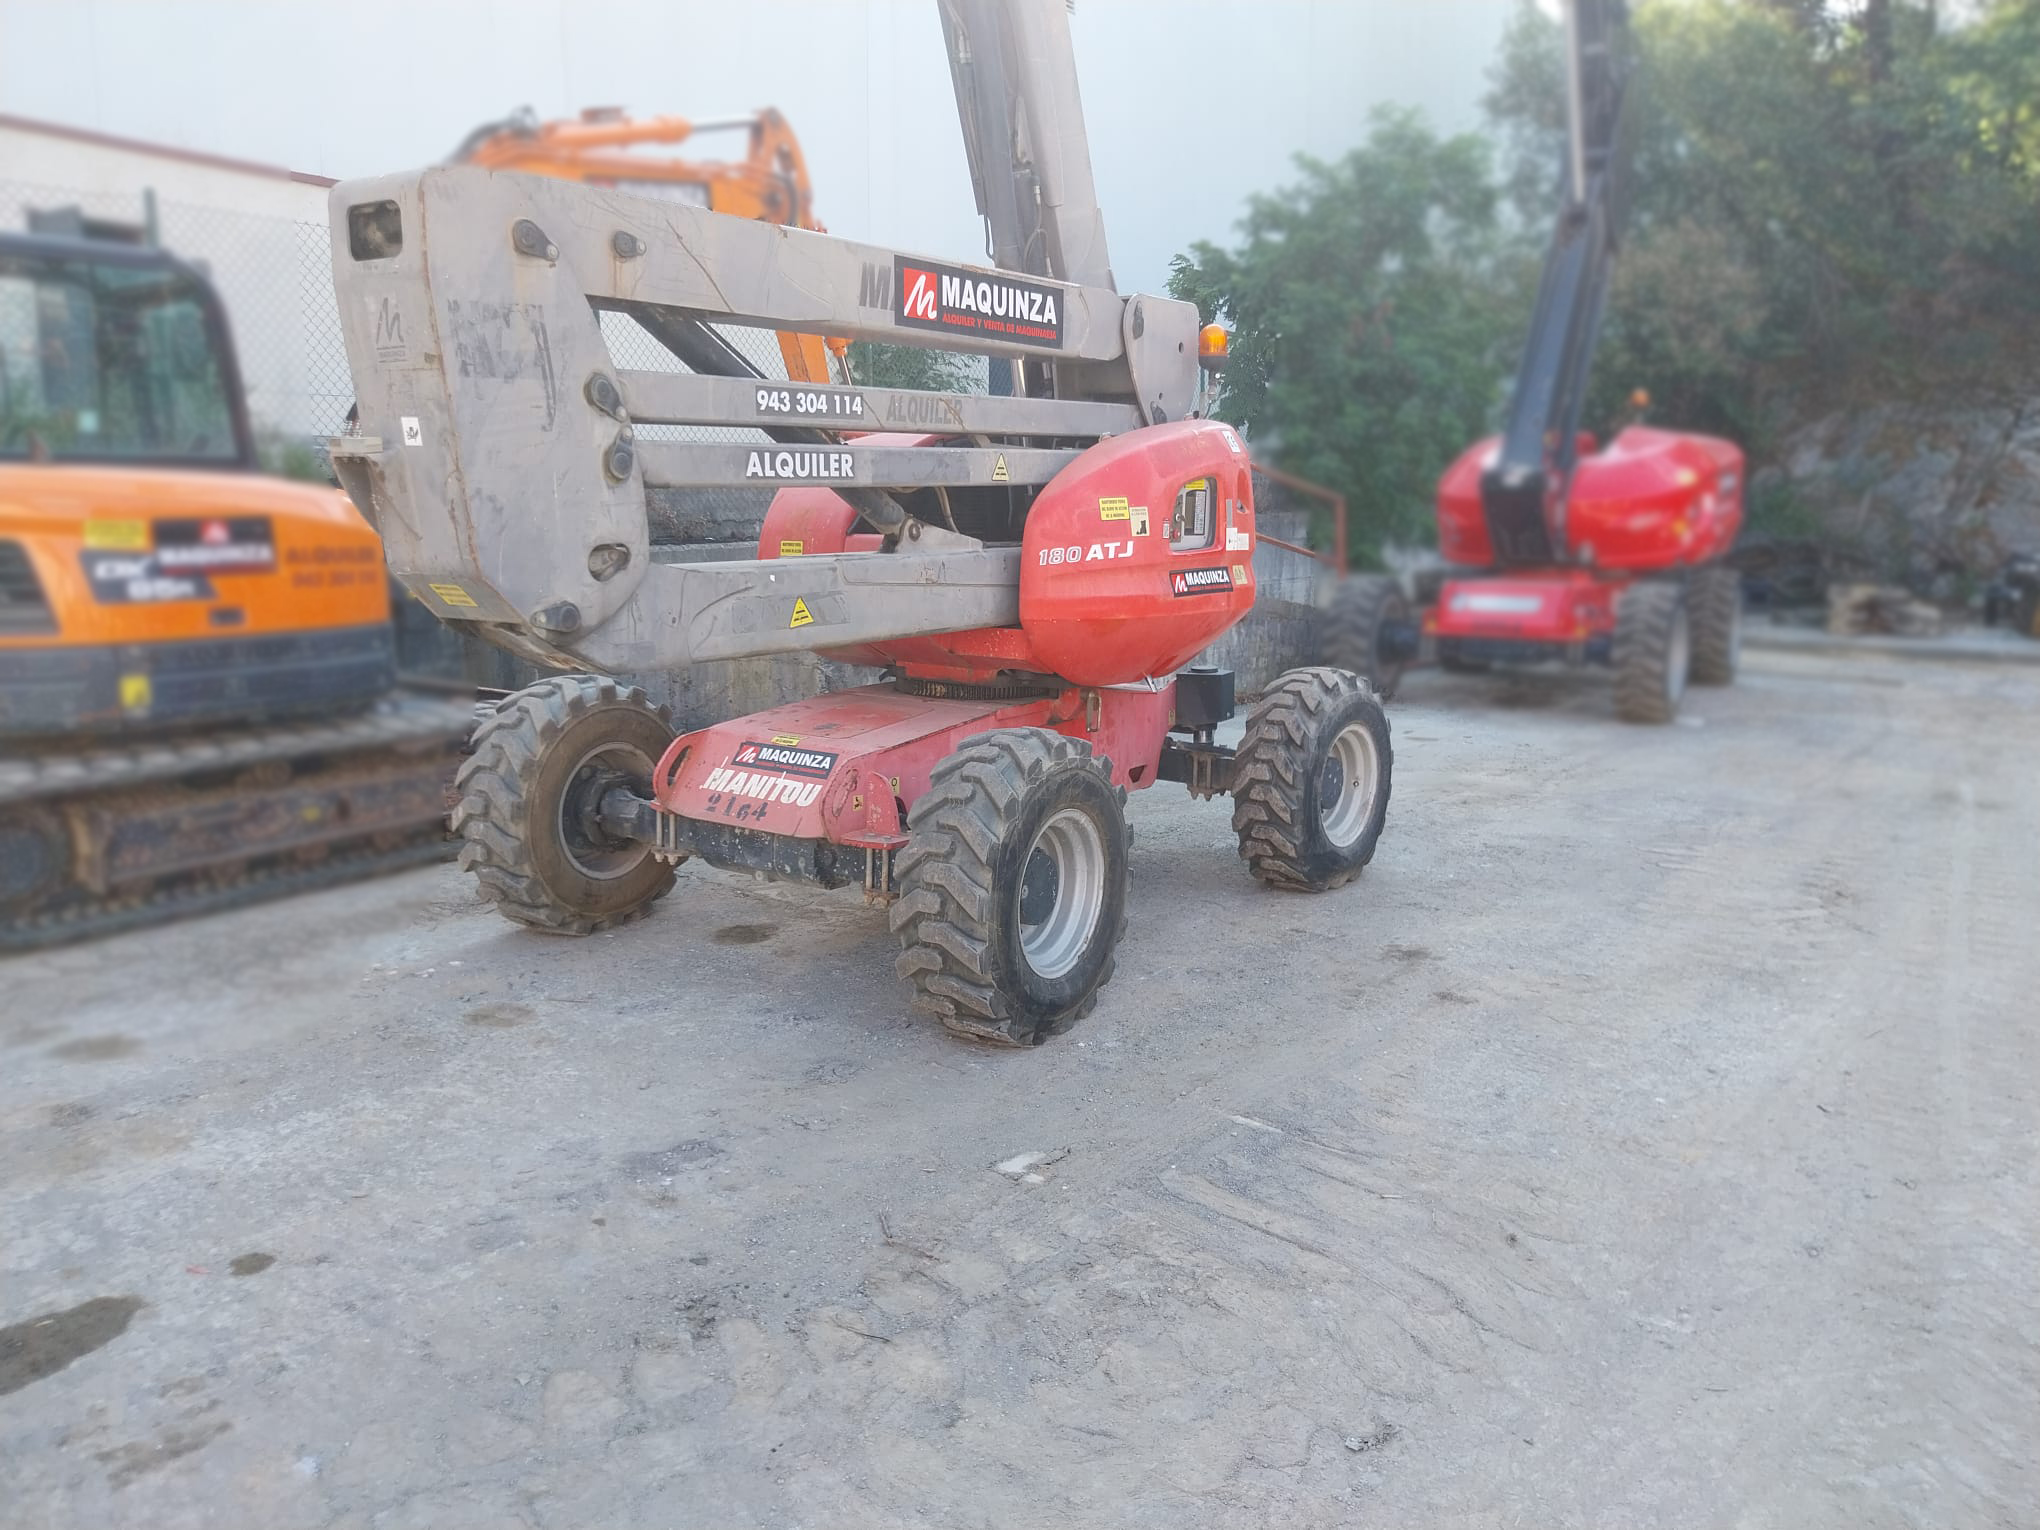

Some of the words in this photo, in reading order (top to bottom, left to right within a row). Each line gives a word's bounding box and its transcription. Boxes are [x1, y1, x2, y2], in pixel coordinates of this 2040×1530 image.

[942, 274, 1057, 325] MAQUINZA
[943, 313, 976, 327] ALQUILER
[977, 319, 983, 329] Y
[984, 320, 1005, 332] VENTA
[1006, 323, 1015, 333] DE
[1016, 325, 1057, 340] MAQUINARIA
[756, 390, 790, 412] 943
[796, 391, 827, 414] 304
[834, 395, 863, 415] 114
[886, 395, 963, 425] ALQUILER
[746, 452, 854, 478] ALQUILER
[1039, 546, 1082, 566] 180
[1085, 540, 1134, 562] ATJ
[1184, 570, 1230, 586] MAQUINZA
[758, 747, 831, 769] MAQUINZA
[701, 766, 823, 807] MANITOU
